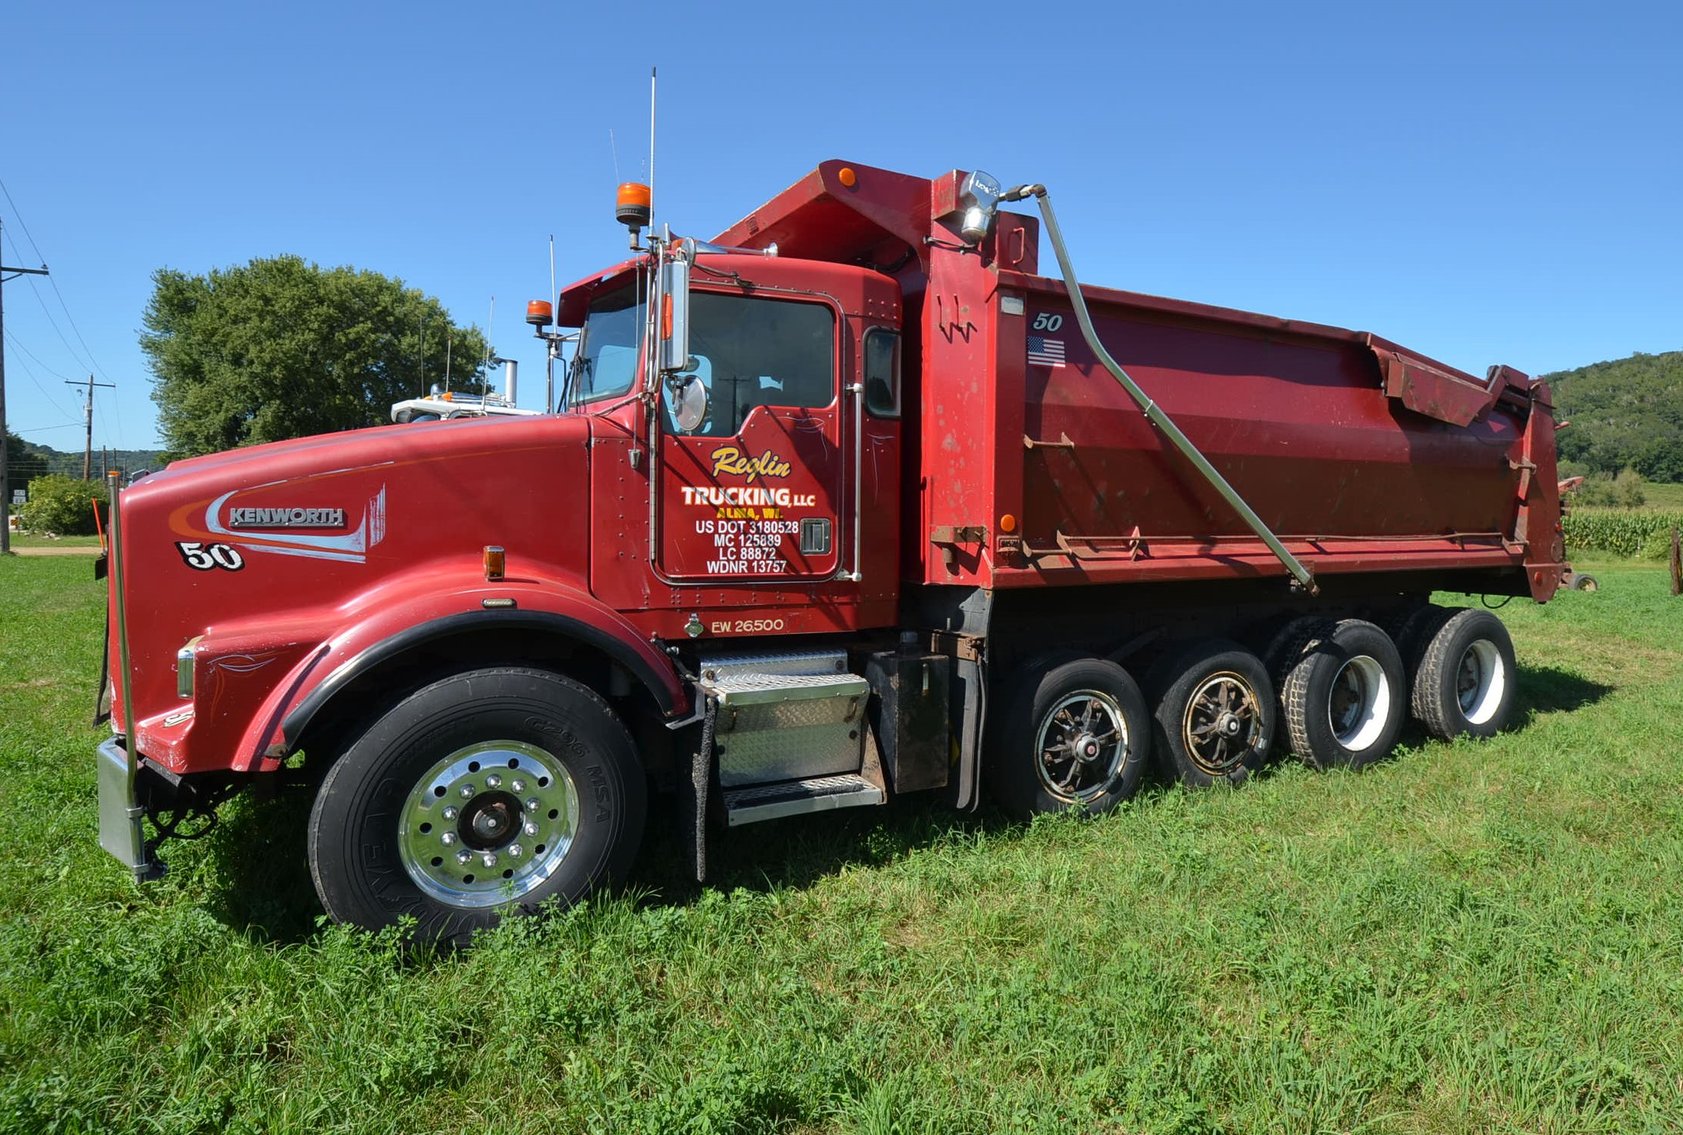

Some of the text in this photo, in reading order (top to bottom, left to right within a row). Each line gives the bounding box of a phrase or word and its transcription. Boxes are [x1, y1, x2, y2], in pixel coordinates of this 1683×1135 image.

[1032, 311, 1063, 332] 50
[711, 446, 791, 484] Reglin
[793, 494, 816, 507] LLC
[229, 507, 345, 527] KENWORTH
[695, 520, 799, 534] US DOT 3180528
[714, 533, 782, 548] MC 125889
[176, 541, 245, 571] 50
[719, 547, 776, 560] LC 88872
[706, 560, 787, 574] WDNR 13757
